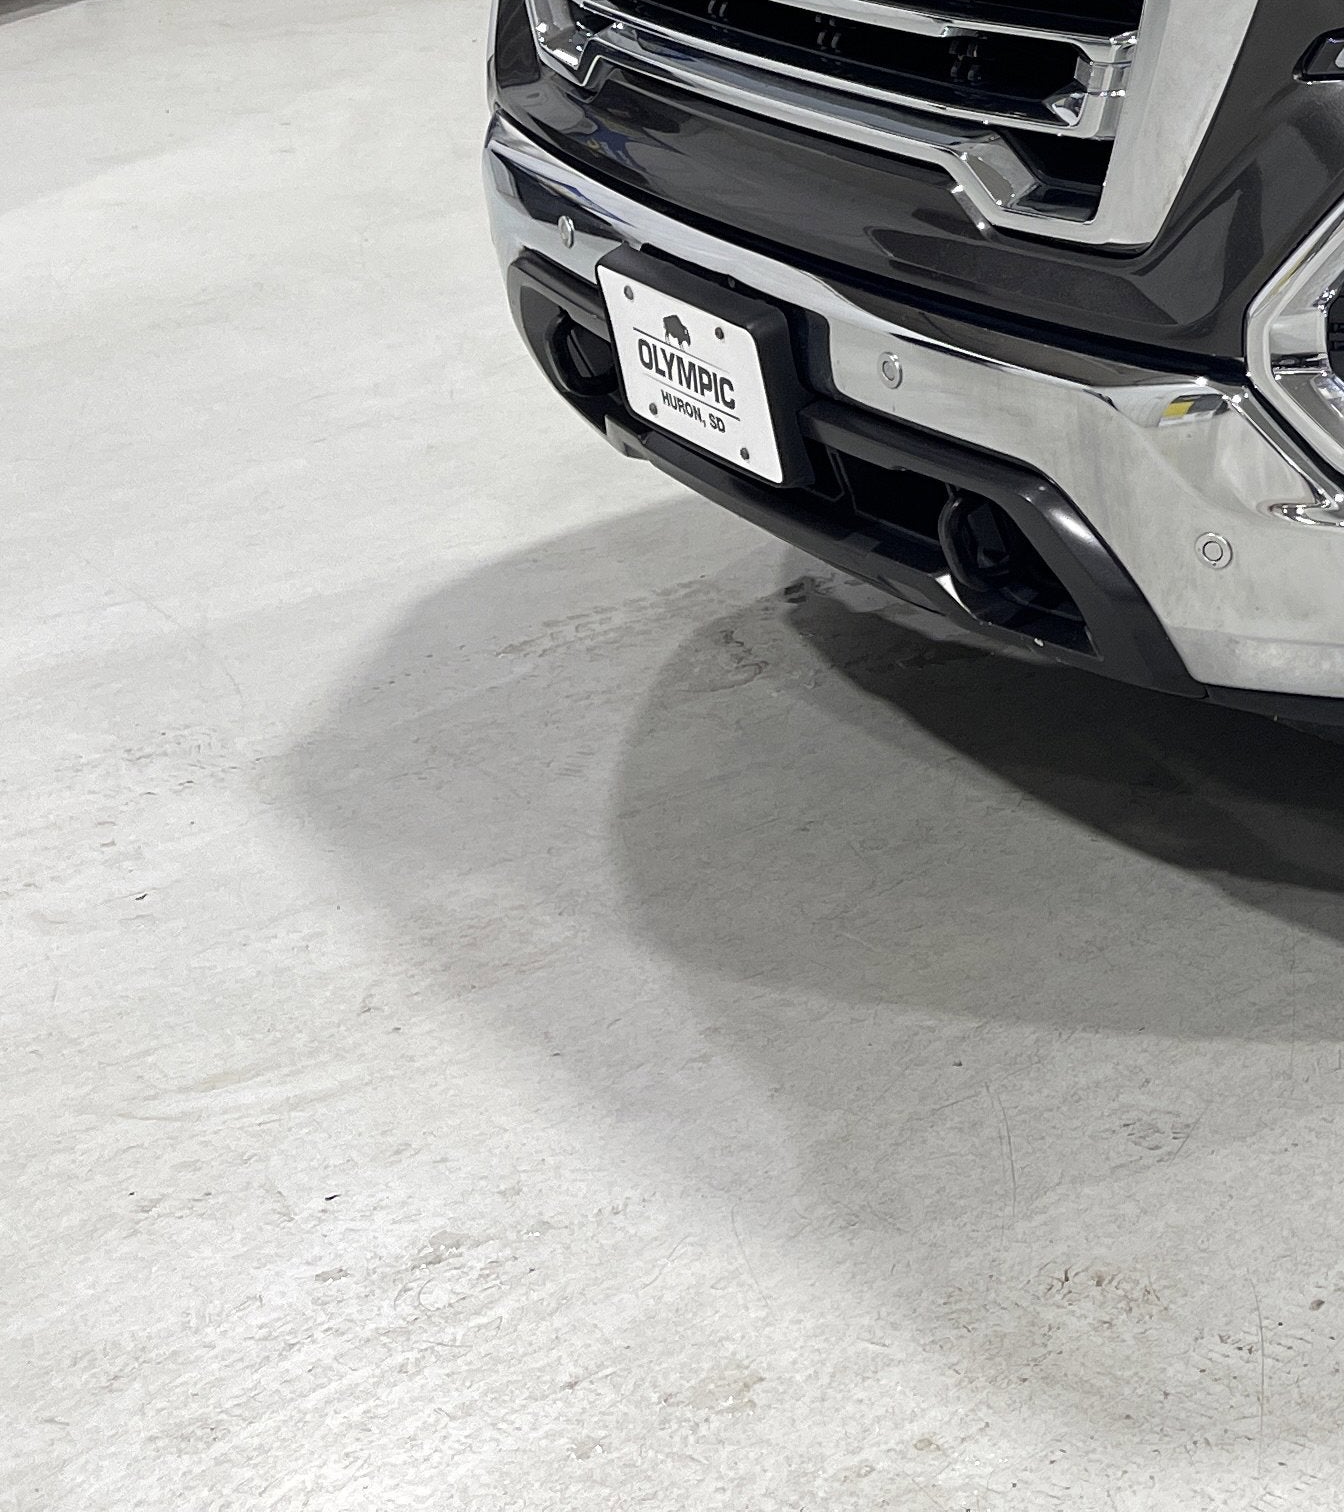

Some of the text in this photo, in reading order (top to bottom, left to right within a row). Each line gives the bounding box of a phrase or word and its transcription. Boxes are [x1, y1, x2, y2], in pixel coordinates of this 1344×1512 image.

[638, 338, 736, 411] OLYMPIC
[661, 389, 726, 433] HURON, SD
